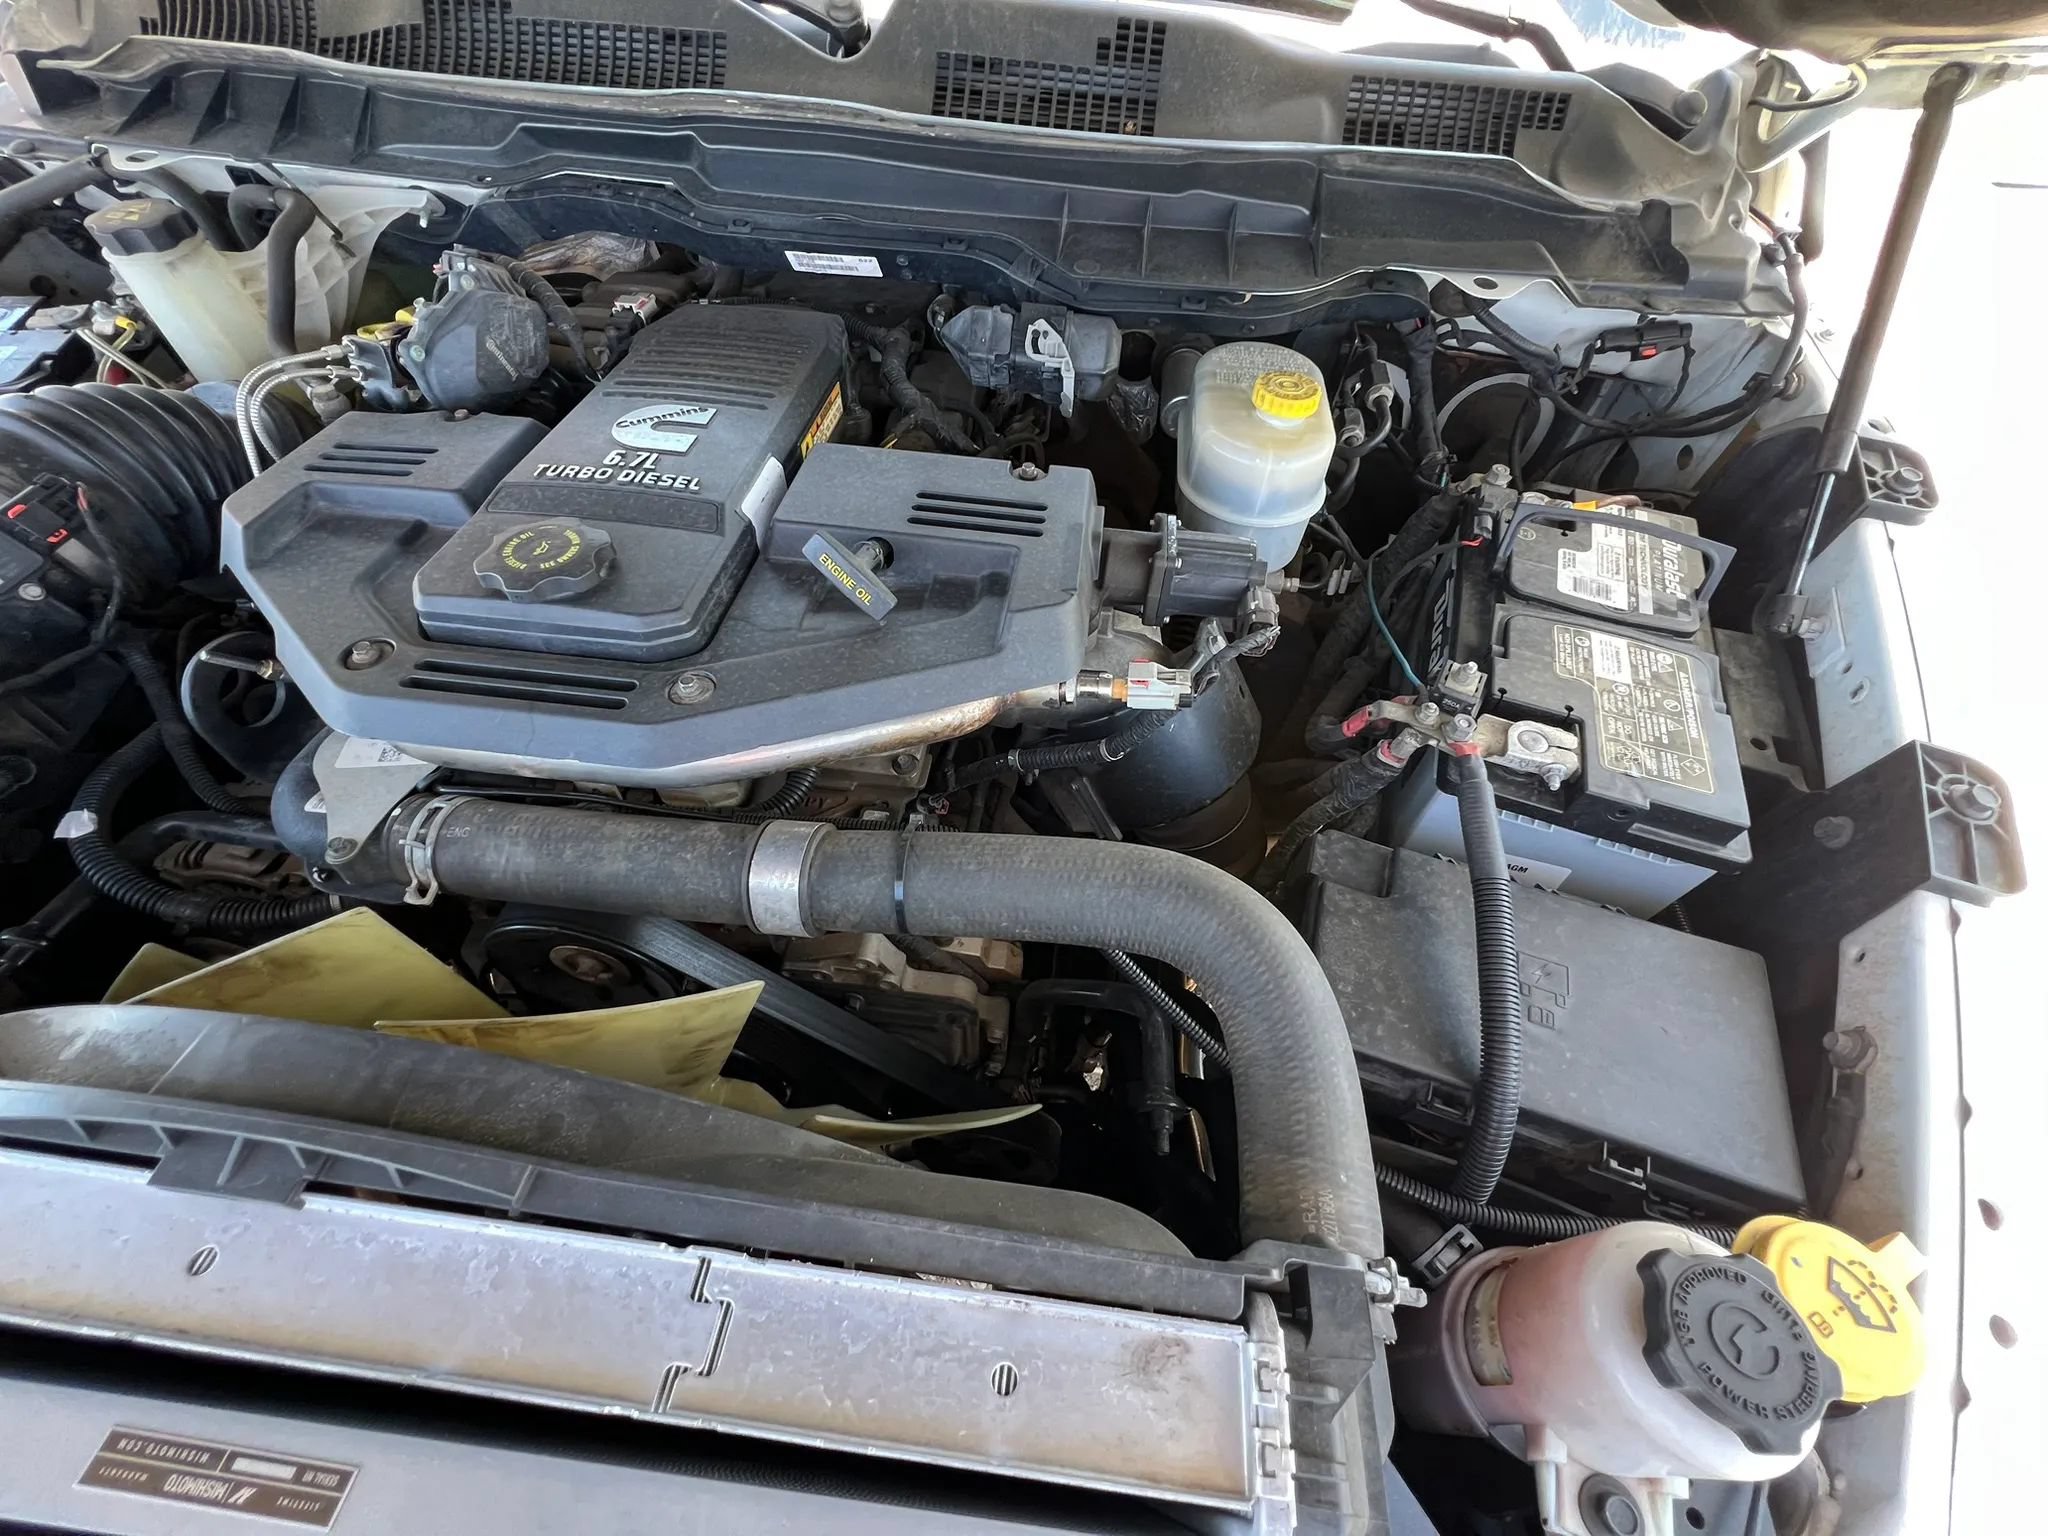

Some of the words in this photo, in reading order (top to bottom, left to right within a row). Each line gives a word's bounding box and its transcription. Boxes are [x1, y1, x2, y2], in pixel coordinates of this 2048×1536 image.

[615, 406, 709, 429] Cummins
[602, 449, 660, 470] 6.7L
[533, 463, 613, 479] TURBO
[617, 469, 700, 491] DIESEL
[520, 531, 535, 540] OIL
[819, 553, 856, 590] ENGINE
[856, 588, 872, 606] OIL
[1653, 550, 1663, 592] PLATINUM
[1662, 539, 1684, 597] Duralast
[446, 827, 471, 838] ENG
[1675, 1266, 1748, 1306] APPROVED
[1673, 1308, 1695, 1346] USE
[1699, 1361, 1769, 1420] POWER
[1773, 1350, 1820, 1420] STEERING
[117, 1438, 211, 1464] MISHIMOTO.COM
[163, 1473, 229, 1501] MISHIMOTO
